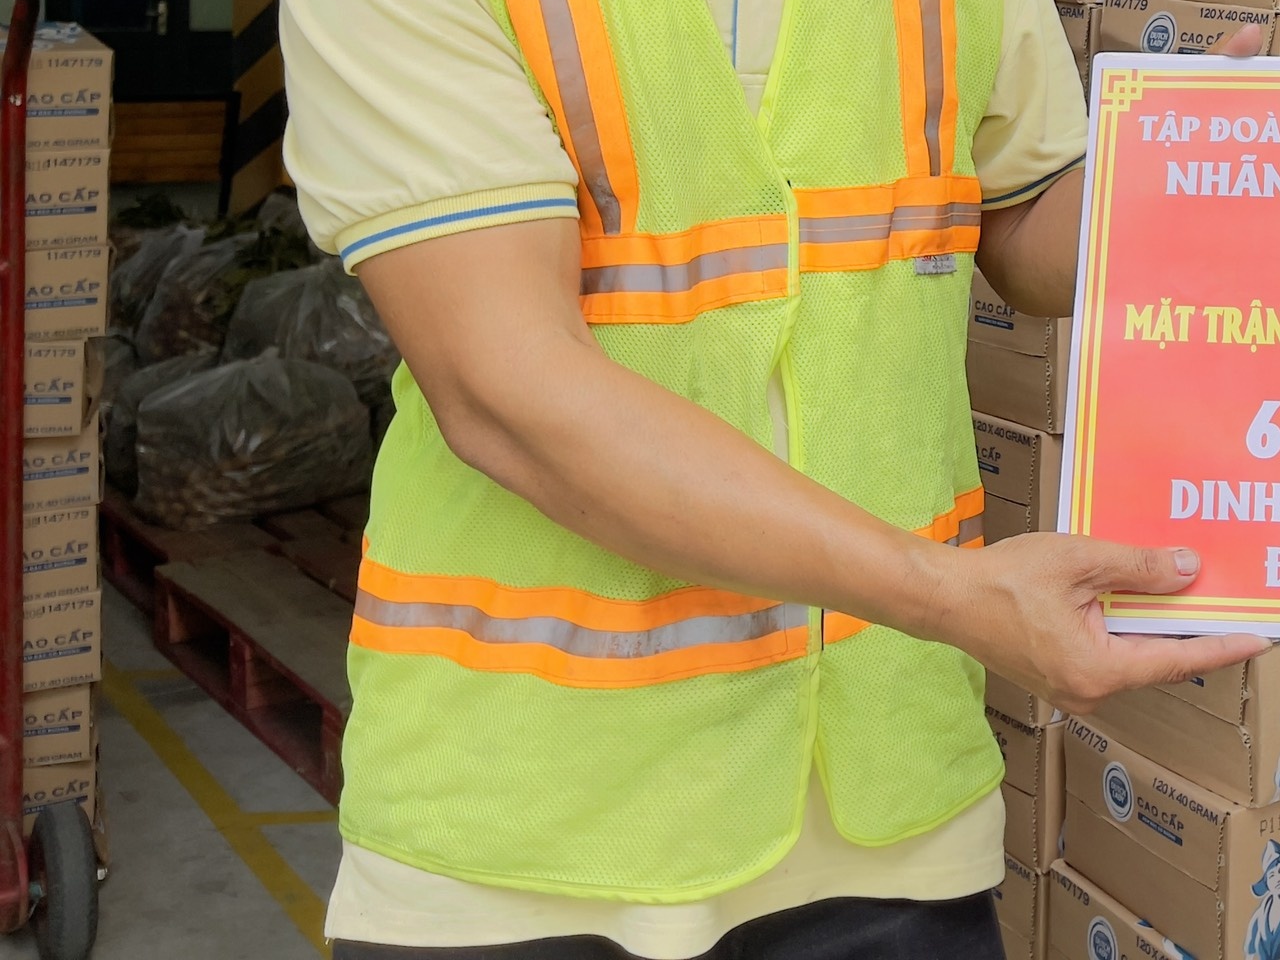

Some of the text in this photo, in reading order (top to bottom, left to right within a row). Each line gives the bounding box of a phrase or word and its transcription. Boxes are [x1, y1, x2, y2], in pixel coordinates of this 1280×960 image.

[1200, 7, 1269, 25] 120 X 40 GRAM
[1150, 32, 1168, 41] DUTCH
[1180, 32, 1204, 44] CAO
[1150, 39, 1164, 48] LADY
[48, 58, 103, 68] 1147179
[27, 94, 54, 104] AO
[1138, 110, 1200, 147] TẬP
[47, 158, 101, 168] 1147179
[26, 193, 52, 204] AO
[47, 250, 101, 260] 1147179
[27, 285, 53, 297] AO
[975, 300, 993, 313] CAO
[1123, 297, 1195, 350] MẶT
[28, 349, 76, 358] 147179
[1006, 431, 1030, 447] GRAM
[23, 458, 45, 468] AO
[23, 550, 43, 560] AO
[42, 600, 94, 614] 1147179
[24, 640, 47, 650] AO
[1066, 718, 1108, 753] 1147179
[22, 792, 46, 802] AO
[1152, 777, 1218, 825] 120 X 40 GRAM
[1137, 796, 1158, 817] CAO
[1161, 812, 1184, 831] CẤP
[1050, 868, 1089, 906] 1147179
